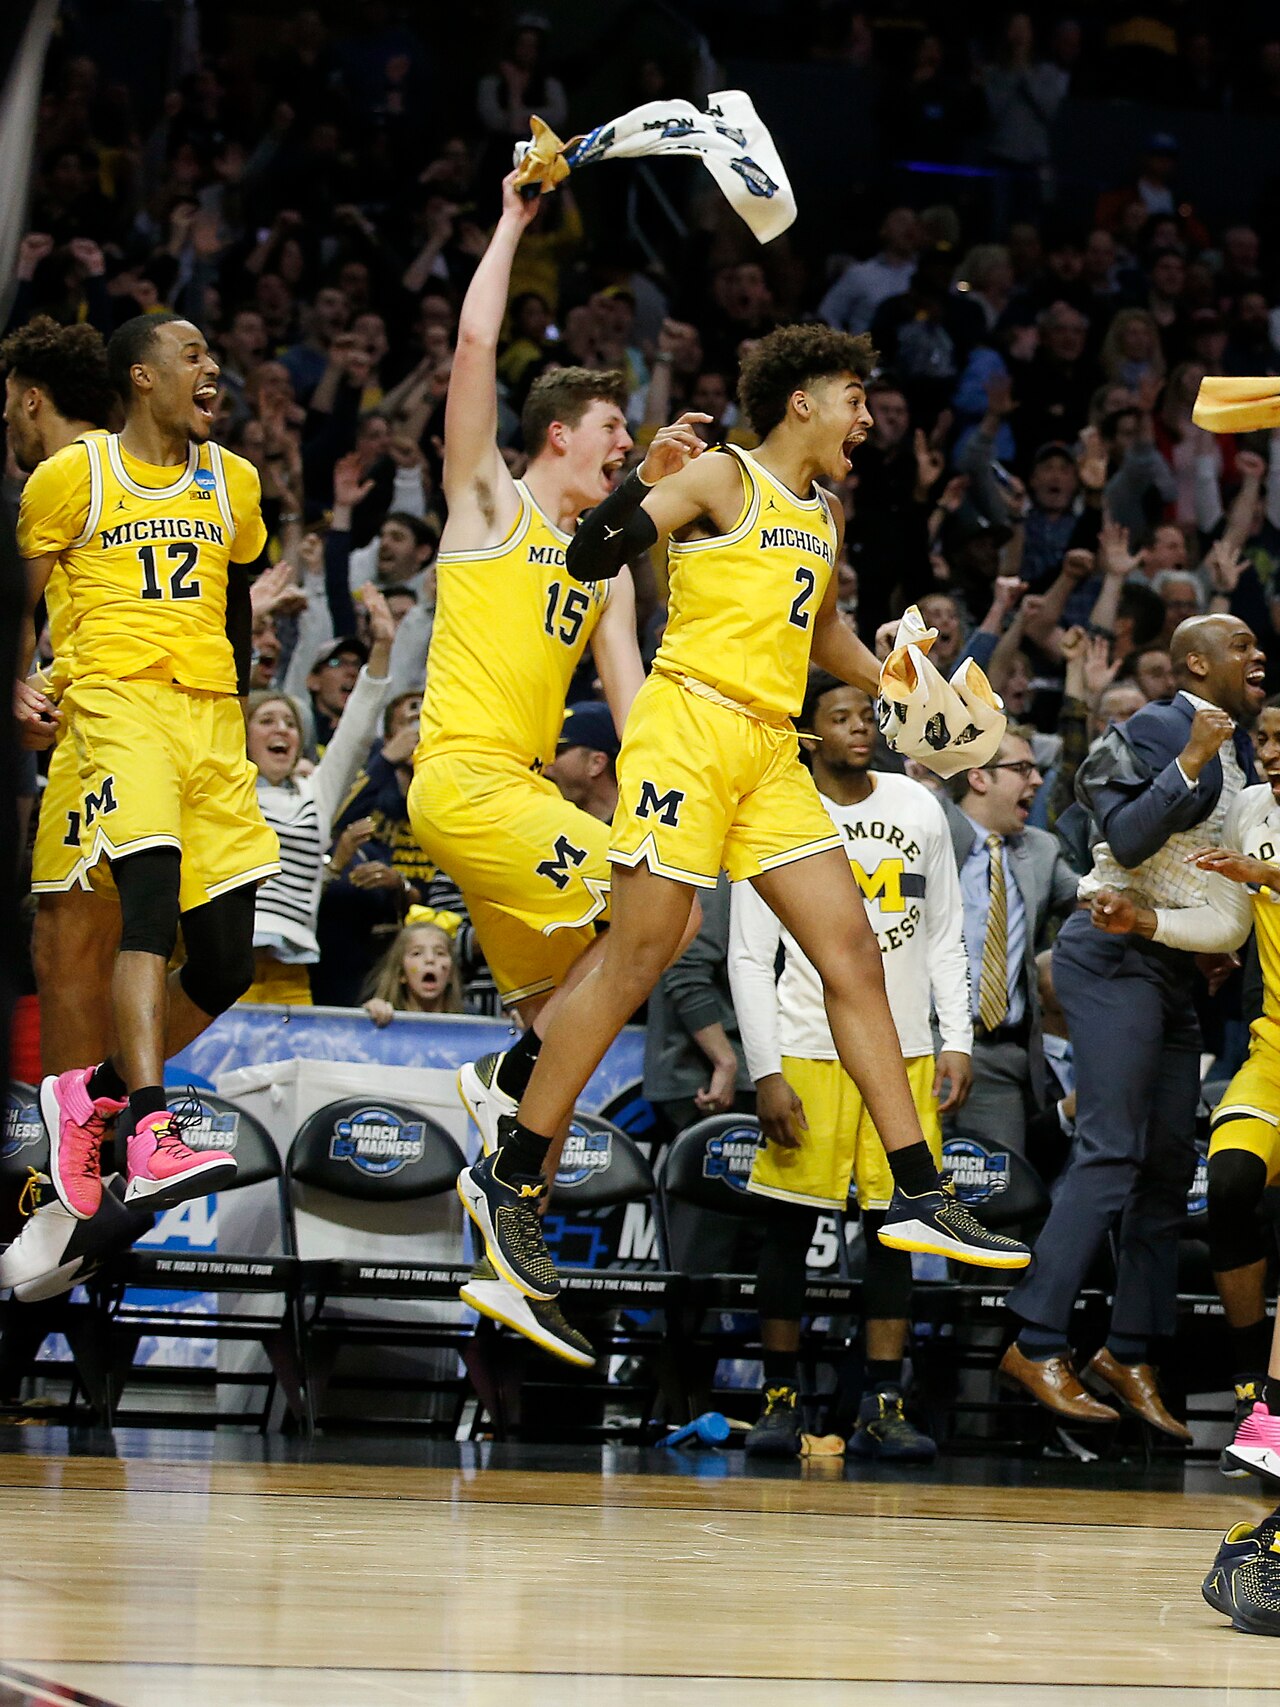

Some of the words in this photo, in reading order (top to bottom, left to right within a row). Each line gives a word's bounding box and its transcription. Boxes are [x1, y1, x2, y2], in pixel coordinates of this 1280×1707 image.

[100, 519, 224, 550] MICHIGAN
[138, 541, 201, 600] 12
[788, 566, 815, 630] 2
[545, 581, 591, 646] 15
[84, 775, 118, 827] M
[635, 780, 685, 828] M
[842, 821, 921, 863] MORE
[535, 834, 588, 890] M
[848, 857, 907, 913] M
[181, 1130, 235, 1148] ADNESS
[351, 1123, 399, 1140] MARCH
[356, 1139, 421, 1156] MADNESS
[722, 1142, 757, 1158] MARC
[942, 1155, 985, 1171] MARCH
[519, 1184, 543, 1197] M
[156, 1260, 172, 1271] THE
[173, 1261, 197, 1272] ROAD
[197, 1262, 208, 1273] TO
[209, 1263, 225, 1274] THE
[225, 1263, 249, 1275] FINAL
[250, 1264, 274, 1276] FOUR
[451, 1272, 471, 1283] FOU
[1234, 1382, 1257, 1399] M
